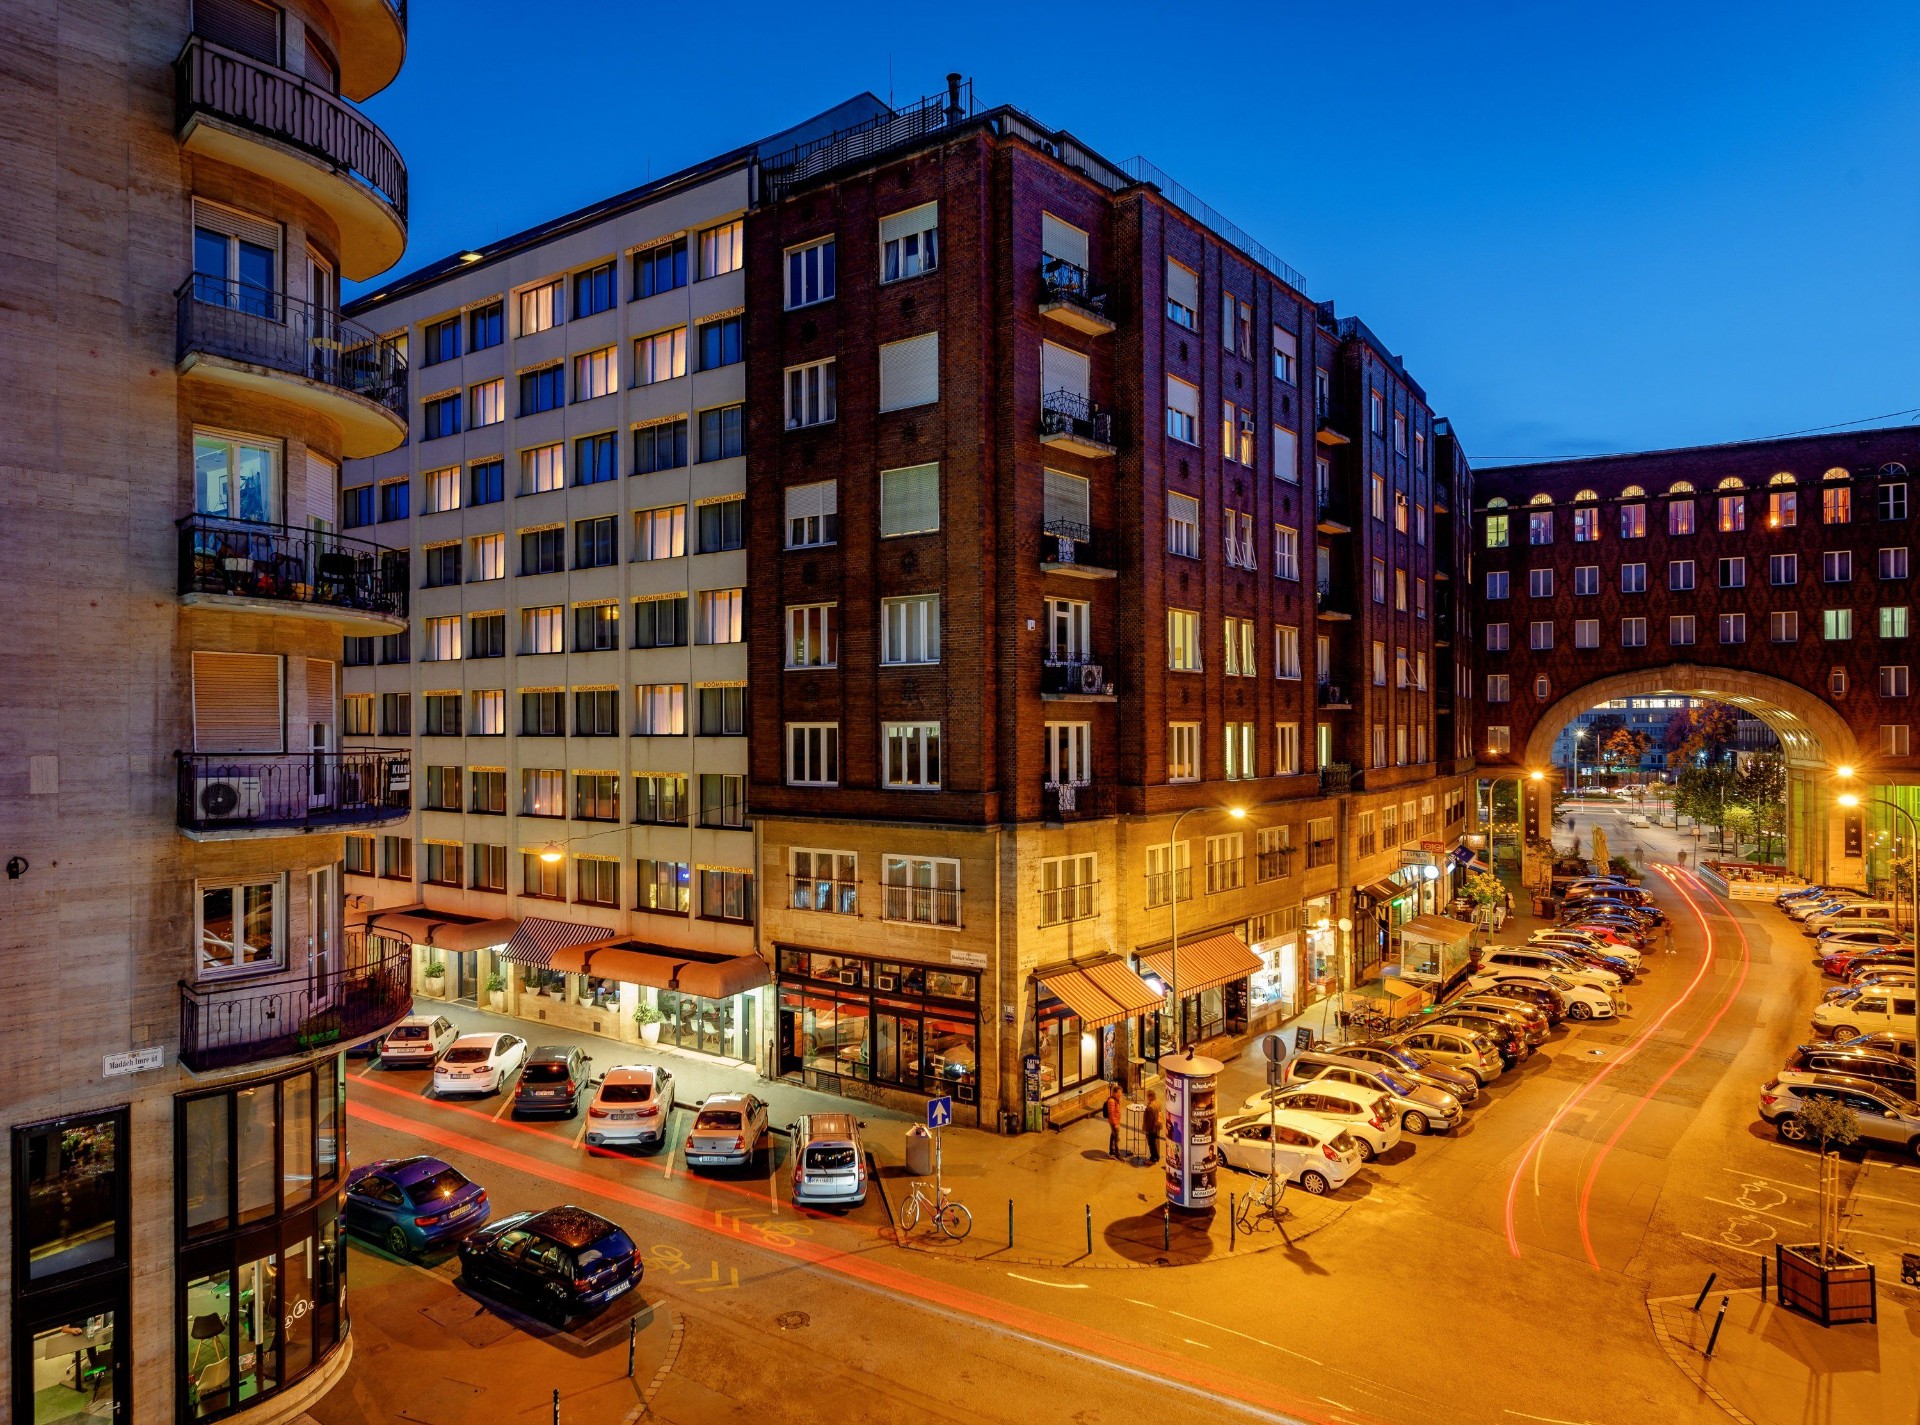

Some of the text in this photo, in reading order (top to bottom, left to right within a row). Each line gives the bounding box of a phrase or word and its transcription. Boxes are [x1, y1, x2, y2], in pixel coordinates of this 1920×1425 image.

[1424, 843, 1444, 851] GIGI
[109, 1059, 134, 1069] Madách
[135, 1056, 150, 1066] Imre
